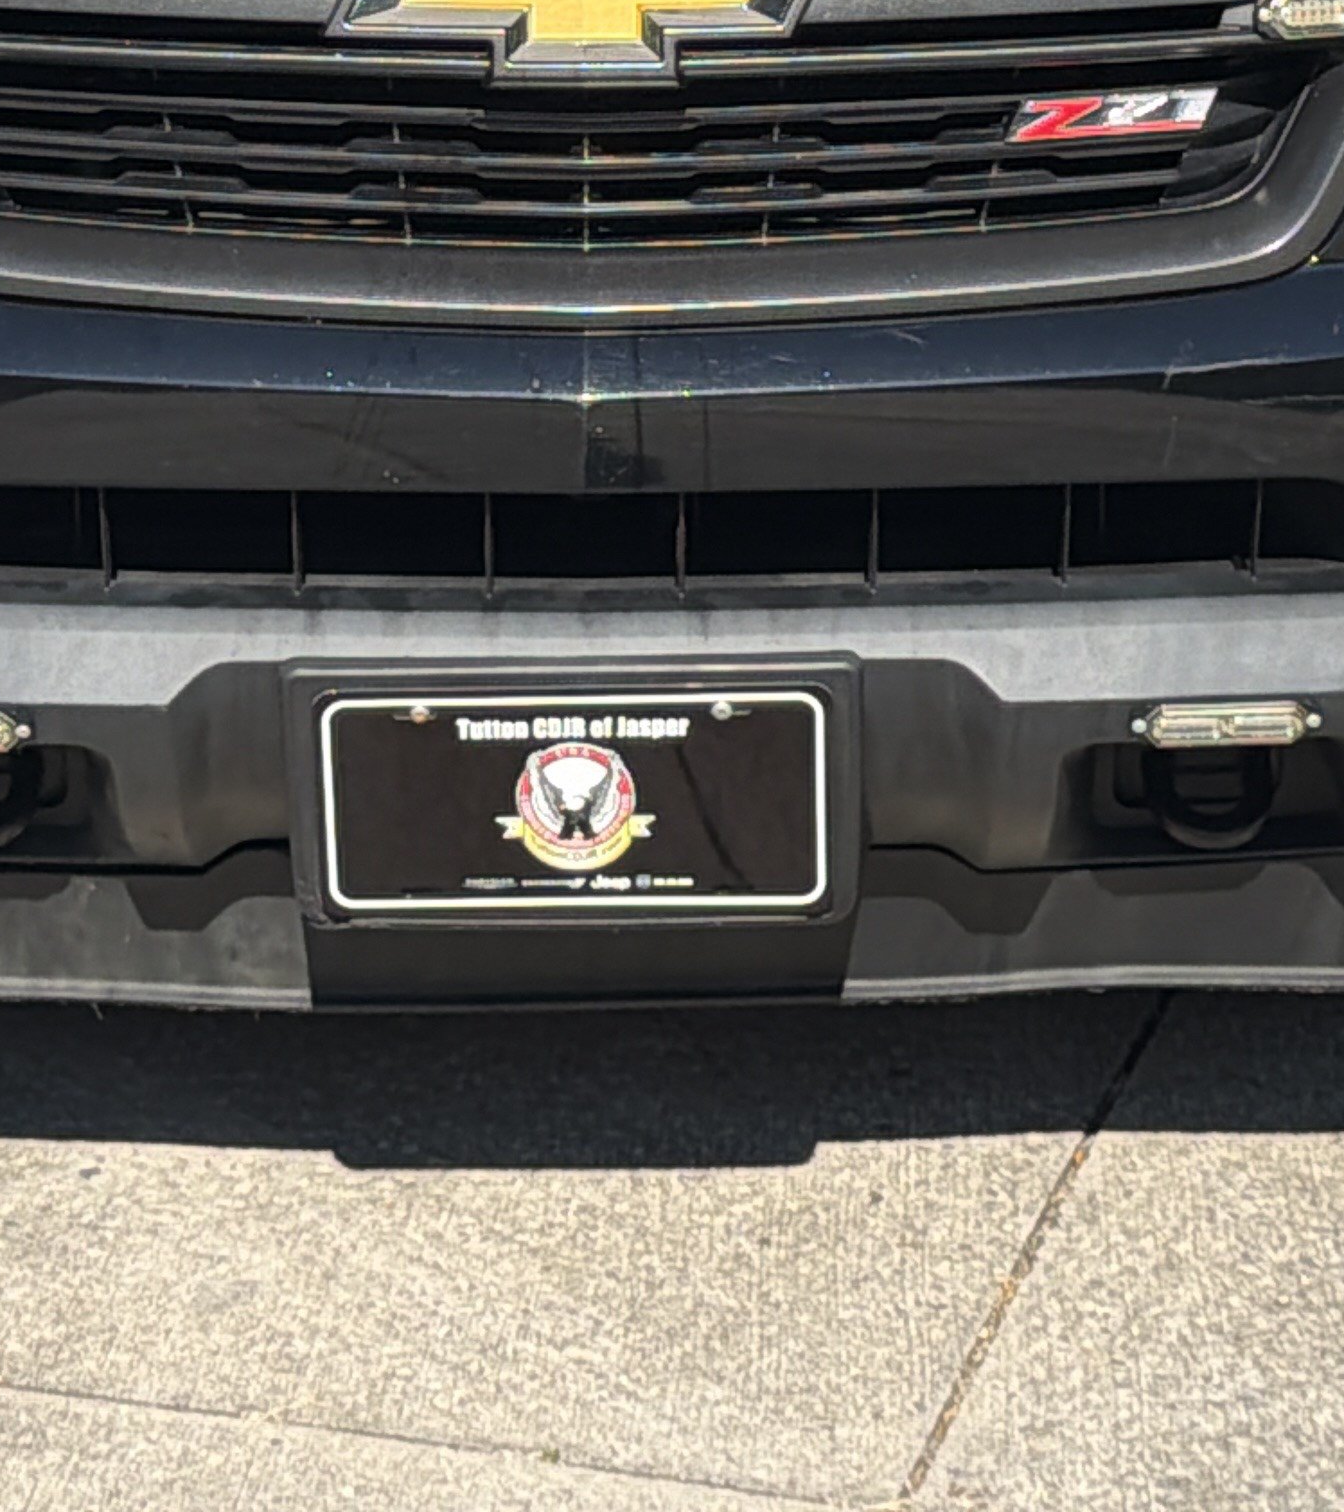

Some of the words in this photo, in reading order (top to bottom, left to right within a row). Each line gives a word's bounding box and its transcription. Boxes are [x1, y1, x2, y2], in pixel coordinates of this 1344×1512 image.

[1007, 89, 1218, 140] Z71
[533, 717, 587, 739] CDJR
[590, 716, 613, 738] of
[616, 716, 690, 739] Jasper
